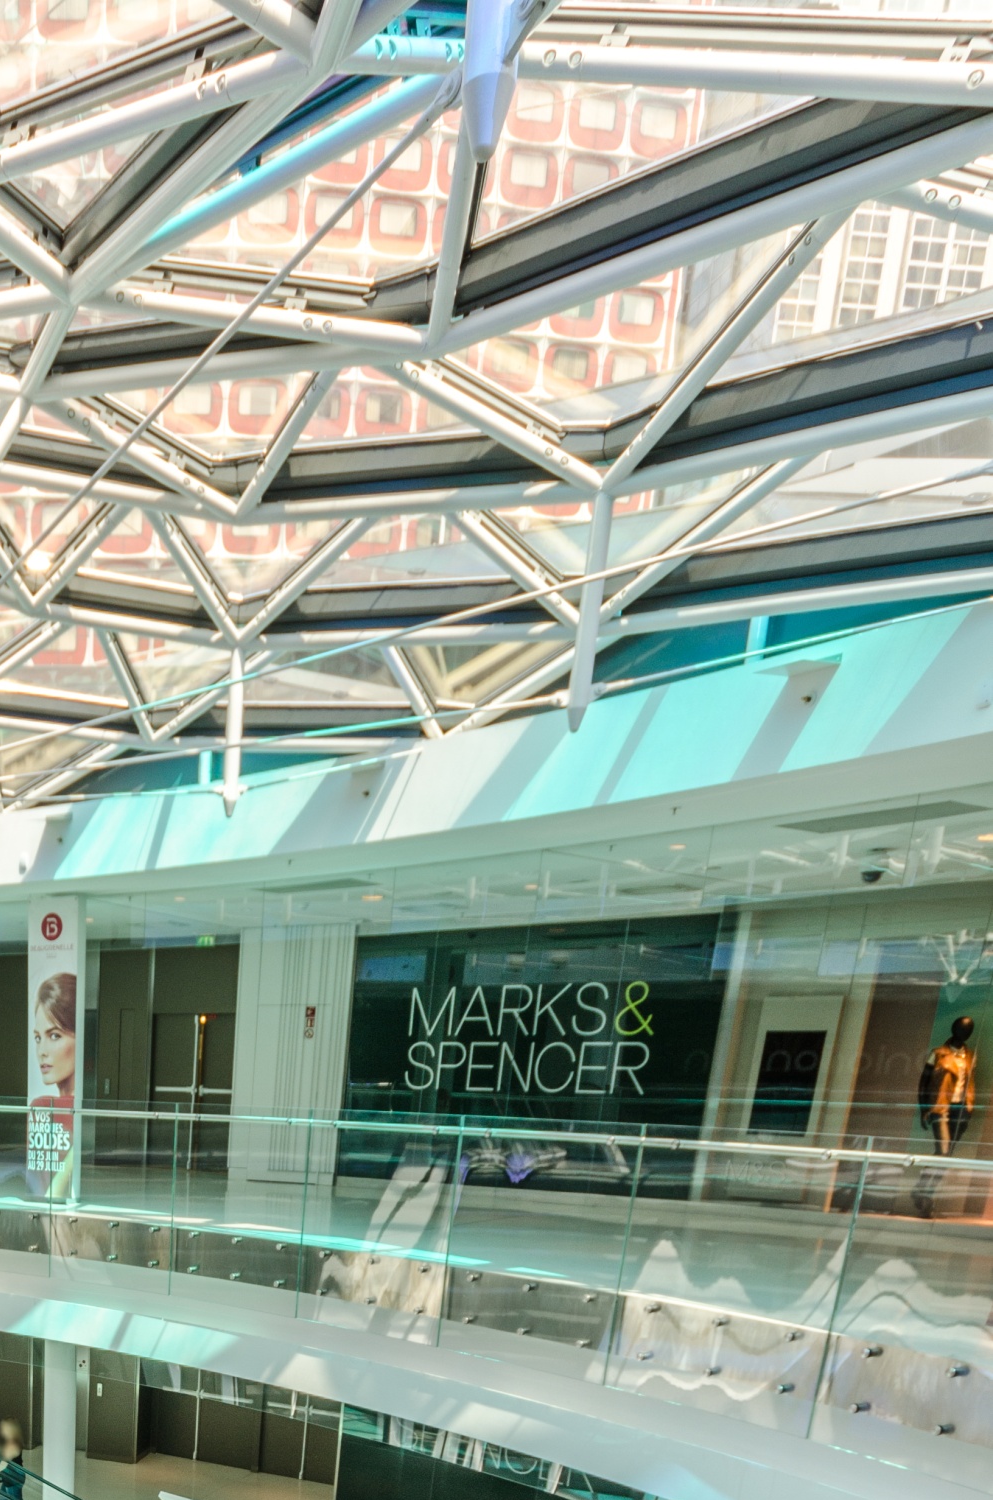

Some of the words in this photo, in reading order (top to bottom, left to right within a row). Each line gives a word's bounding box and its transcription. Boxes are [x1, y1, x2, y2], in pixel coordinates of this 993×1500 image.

[404, 1041, 650, 1096] SPENCER
[35, 1111, 51, 1123] VOS
[28, 1132, 71, 1150] SOLDES
[28, 1150, 36, 1160] DU
[36, 1150, 45, 1161] 25
[27, 1160, 36, 1170] AU
[36, 1160, 44, 1171] 29
